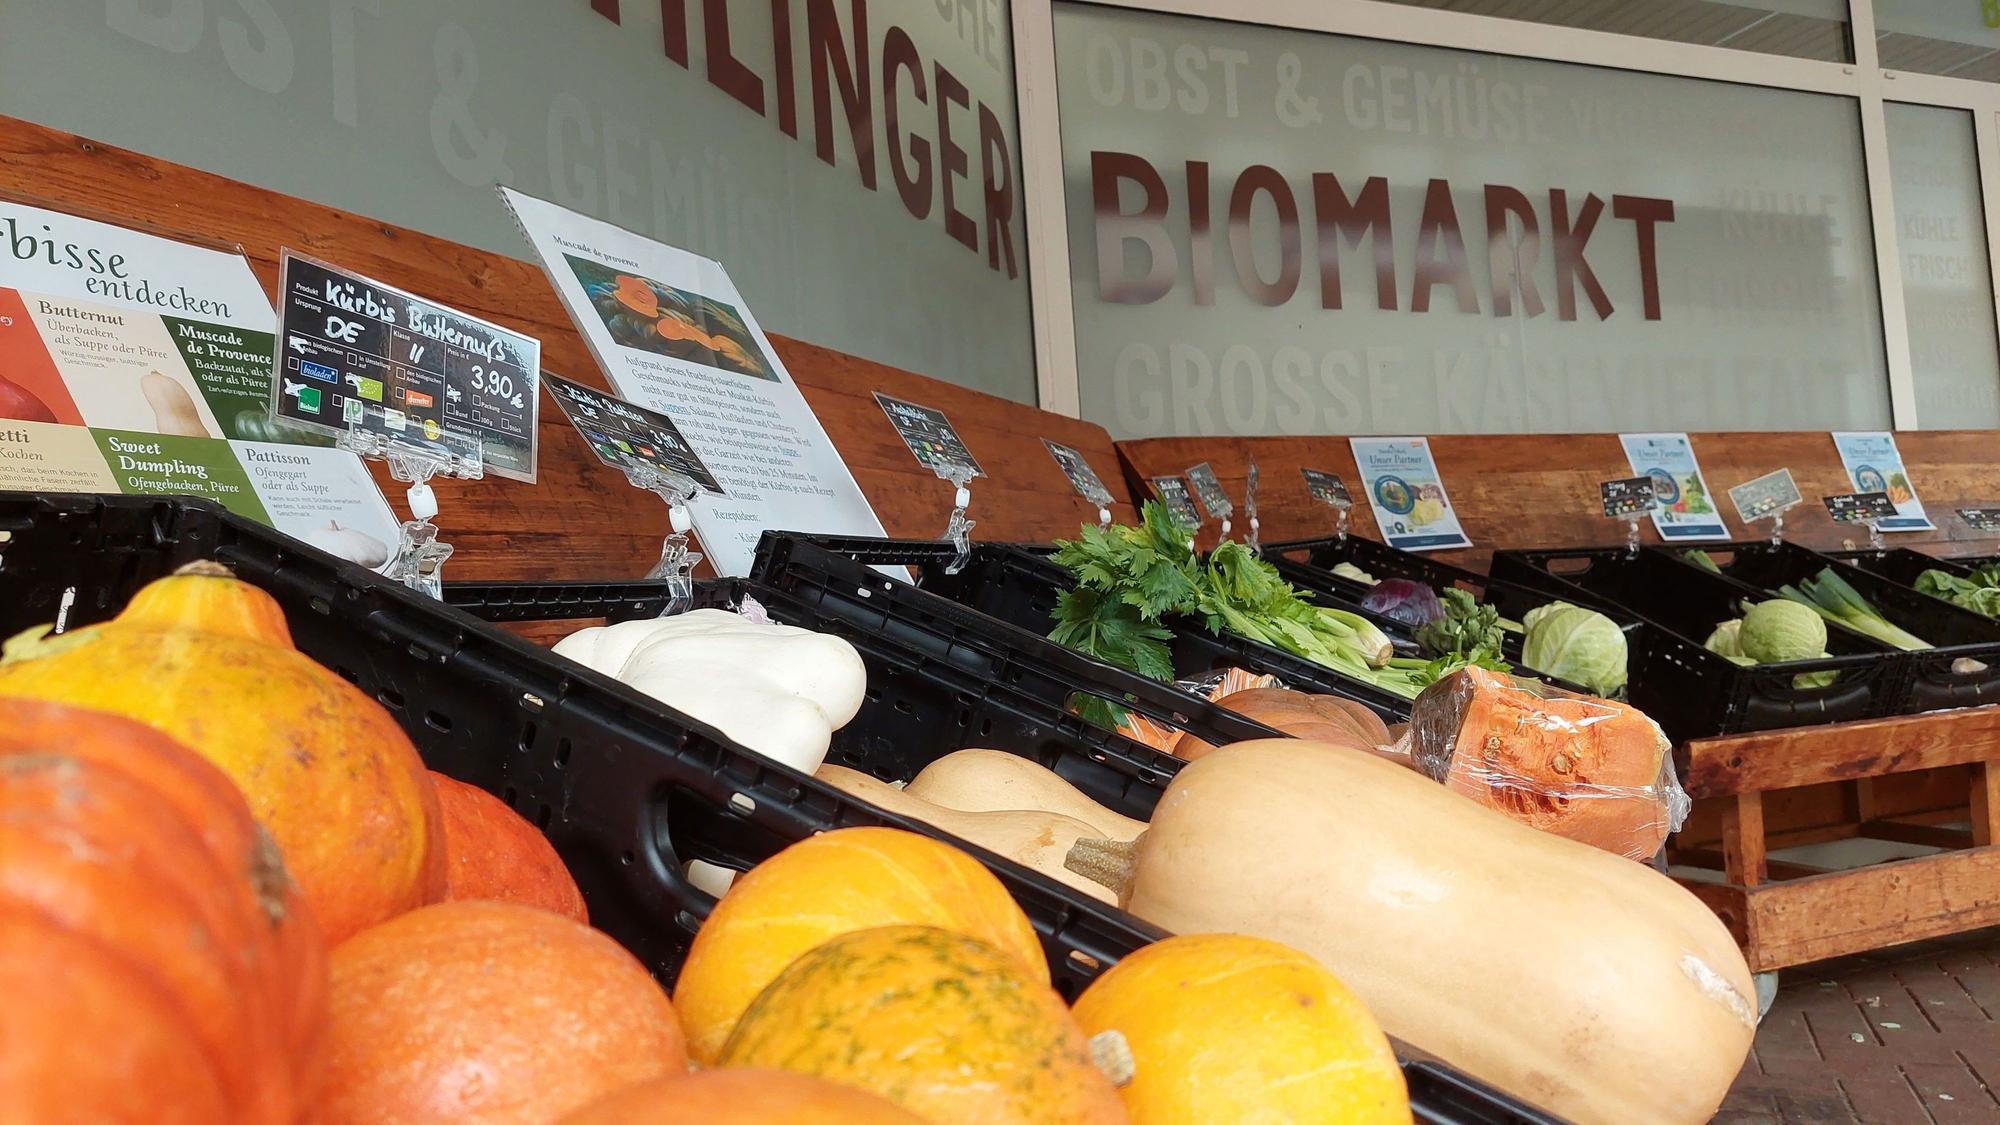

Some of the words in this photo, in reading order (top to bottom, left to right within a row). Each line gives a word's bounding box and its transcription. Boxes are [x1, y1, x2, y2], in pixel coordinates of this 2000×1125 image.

[1086, 34, 1249, 118] OBST
[1275, 52, 1323, 129] &
[1343, 62, 1549, 144] GEMÜSE
[1902, 209, 1960, 241] KÜHLE
[1090, 150, 1675, 321] BIOMARKT
[0, 218, 128, 278] bisse
[552, 234, 591, 254] Muscade
[592, 248, 602, 257] de
[602, 251, 641, 271] provence
[86, 277, 232, 318] entdecken
[295, 282, 318, 295] Produkt
[325, 278, 395, 322] Kürbis
[39, 300, 124, 326] Butternut
[294, 298, 321, 313] Ursprung
[324, 315, 365, 346] DE
[47, 318, 119, 340] Überbacken,
[178, 323, 243, 346] Muscade
[393, 330, 410, 340] Klasse
[54, 335, 71, 347] als
[74, 336, 110, 353] Suppe
[112, 344, 135, 353] oder
[139, 345, 168, 359] Püree
[187, 340, 204, 354] de
[207, 343, 272, 365] Provence
[447, 347, 458, 356] Preis
[194, 358, 249, 376] Backzutat,
[250, 367, 264, 377] als
[303, 363, 332, 380] bioladen
[365, 358, 391, 371] Umstellung
[623, 354, 662, 373] Aufgrund
[201, 372, 223, 382] oder
[226, 375, 240, 385] als
[241, 376, 268, 388] Püree
[631, 369, 680, 388] Geschmacks
[640, 382, 662, 397] nicht
[1113, 342, 1407, 435] GROSSE
[455, 409, 468, 418] Bund
[481, 401, 500, 413] Packung
[445, 421, 471, 434] Grundpreis
[108, 436, 162, 455] Sweet
[714, 447, 741, 461] Garzeit
[244, 448, 311, 466] Pattisson
[118, 455, 209, 480] Dumpling
[255, 466, 307, 481] Ofengegart
[128, 476, 209, 493] Ofengebacken,
[212, 481, 240, 493] Püree
[262, 481, 282, 491] oder
[286, 482, 299, 491] als
[302, 482, 330, 496] Suppe
